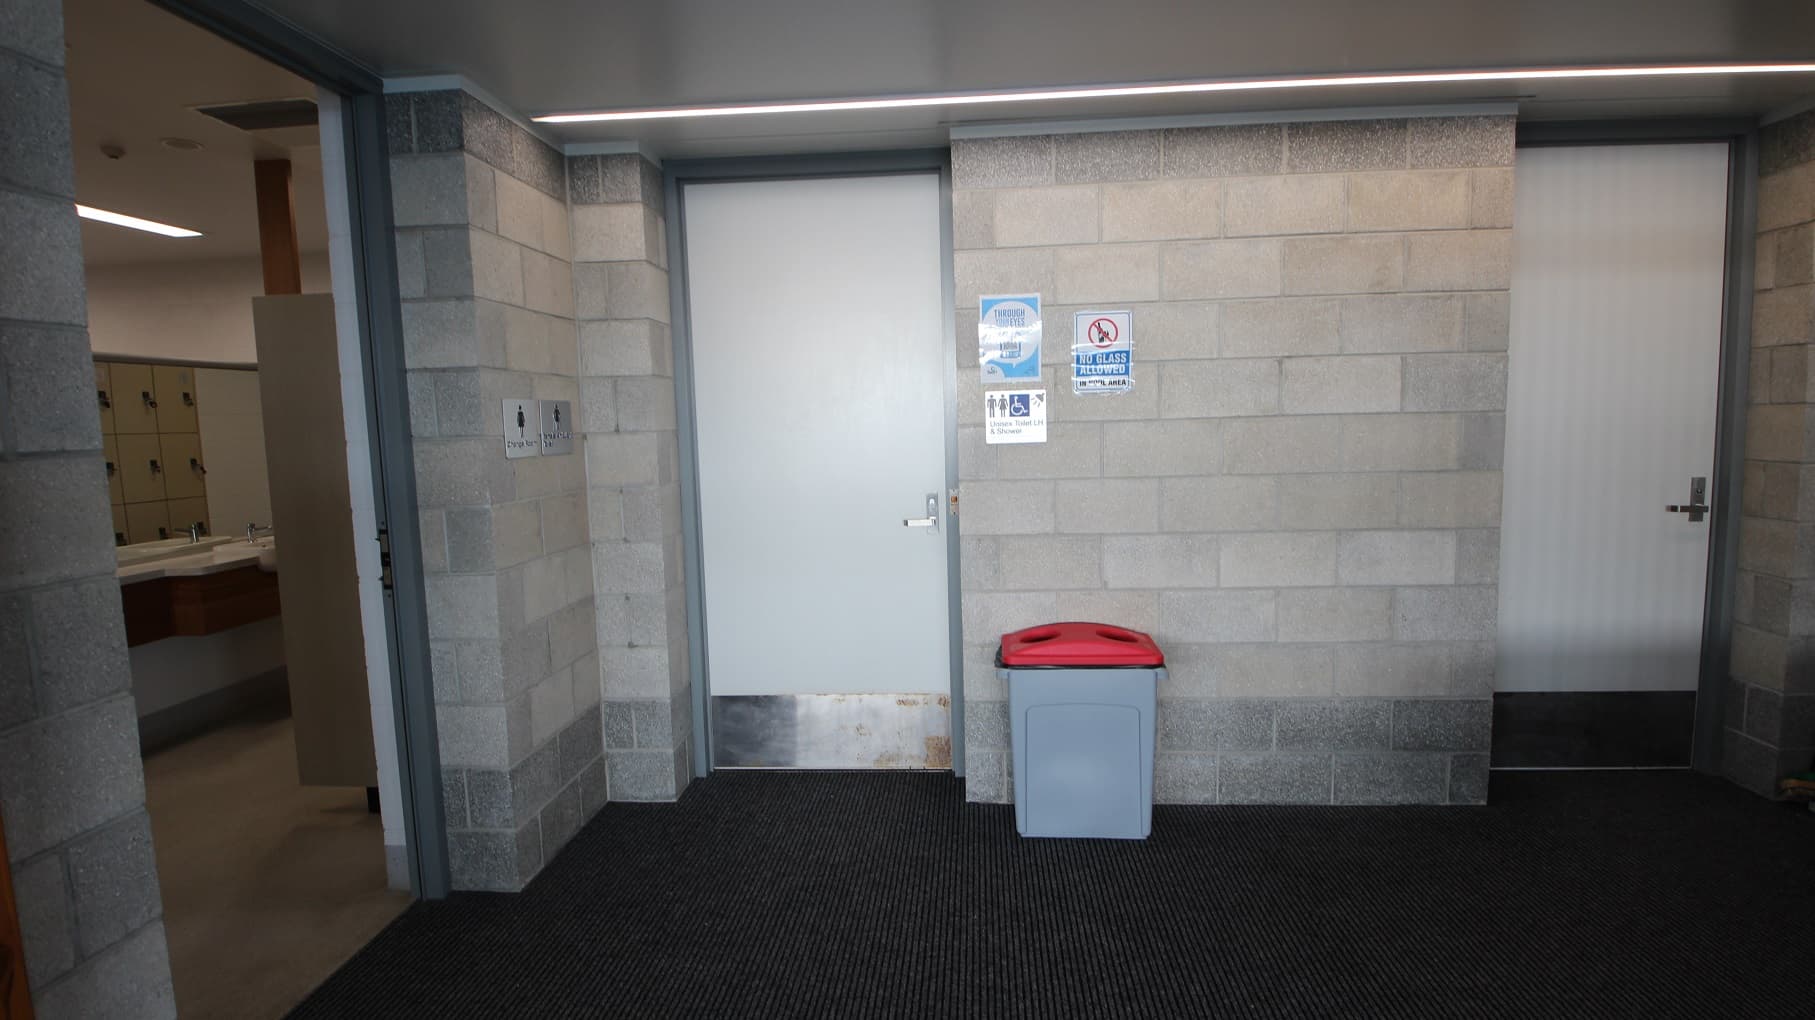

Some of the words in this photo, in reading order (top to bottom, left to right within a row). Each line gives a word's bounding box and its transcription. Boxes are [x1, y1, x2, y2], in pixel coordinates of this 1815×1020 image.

[994, 309, 1025, 318] THROUGH
[1010, 318, 1025, 327] EYES
[1080, 354, 1093, 364] NO
[1096, 352, 1127, 364] GLASS
[1080, 364, 1126, 375] ALLOWED
